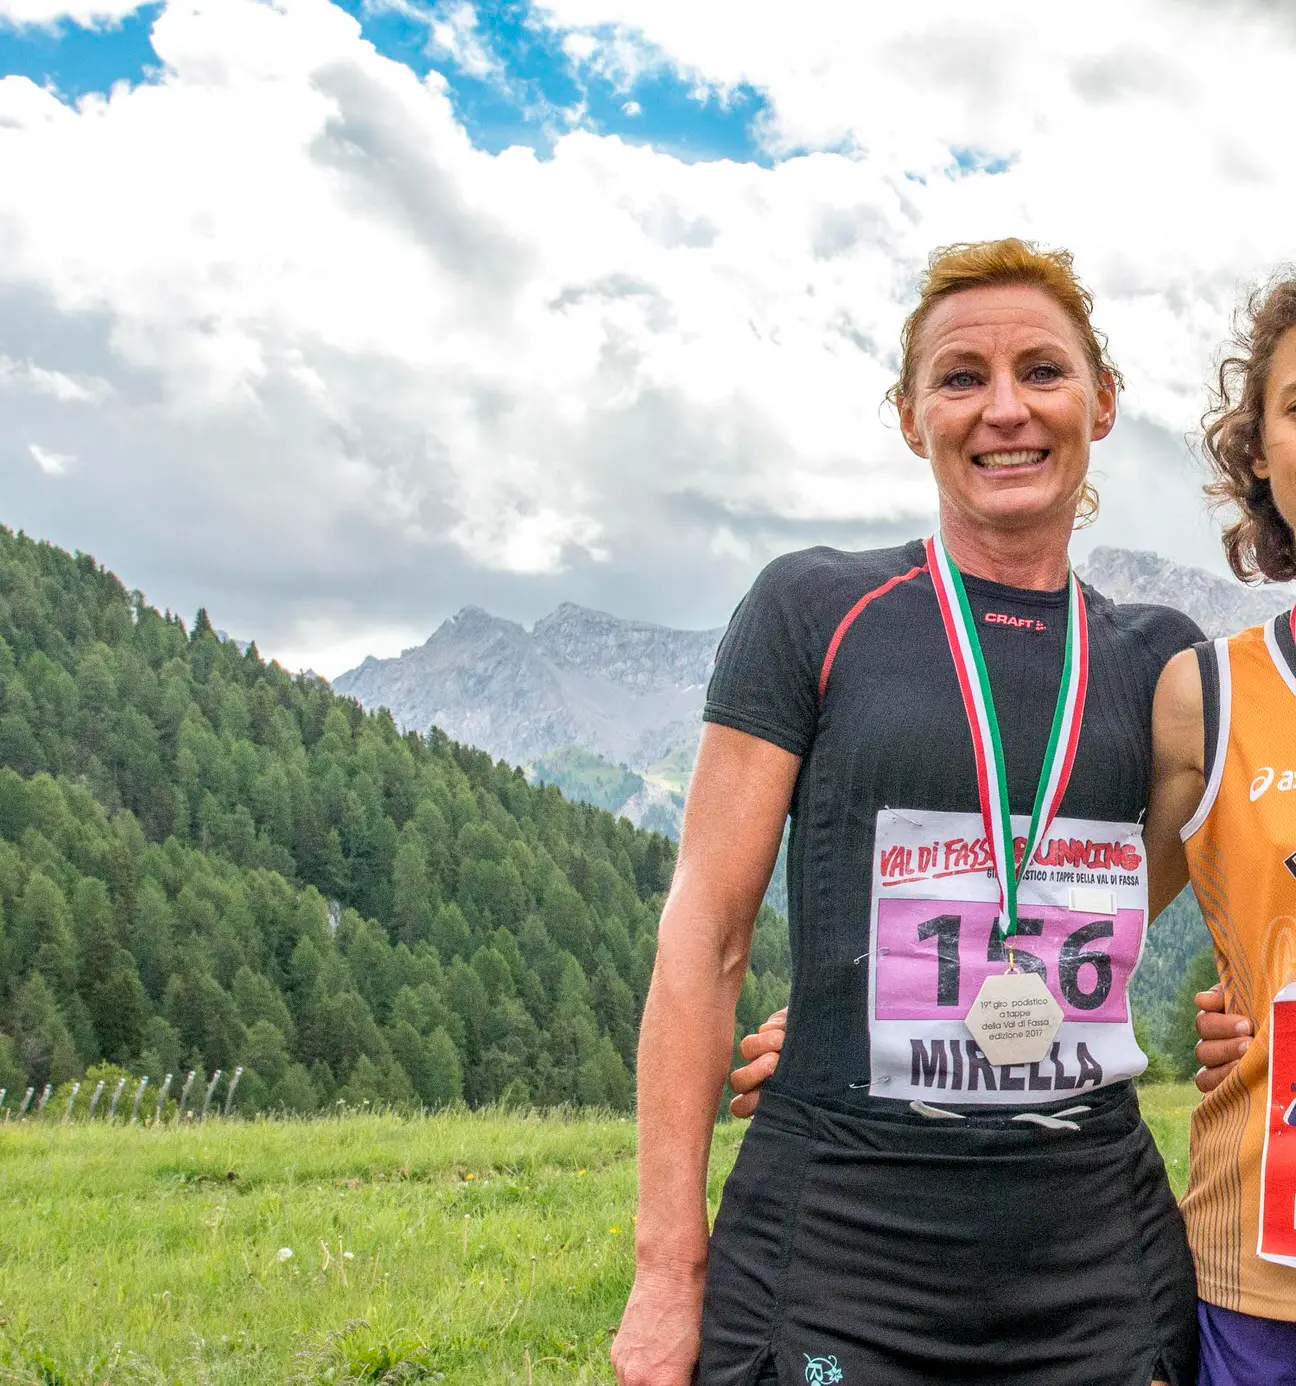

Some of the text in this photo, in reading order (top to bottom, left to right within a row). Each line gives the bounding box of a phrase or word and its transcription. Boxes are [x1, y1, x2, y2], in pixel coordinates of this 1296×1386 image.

[984, 612, 1034, 629] CRAFT
[880, 845, 915, 877] VAL
[943, 837, 994, 871] FASS
[1056, 871, 1075, 883] TAPPE
[1076, 873, 1096, 884] DELLA
[1097, 874, 1109, 885] VAL
[1110, 875, 1118, 885] DI
[1119, 875, 1140, 887] FASSA
[917, 914, 1114, 1011] 156
[993, 1000, 1008, 1010] giro
[1011, 998, 1048, 1008] podistico
[999, 1010, 1031, 1019] a tappe
[981, 1019, 1049, 1031] della Val di Fassa
[988, 1029, 1043, 1041] edizione 2017
[910, 1039, 1103, 1091] MIRELLA
